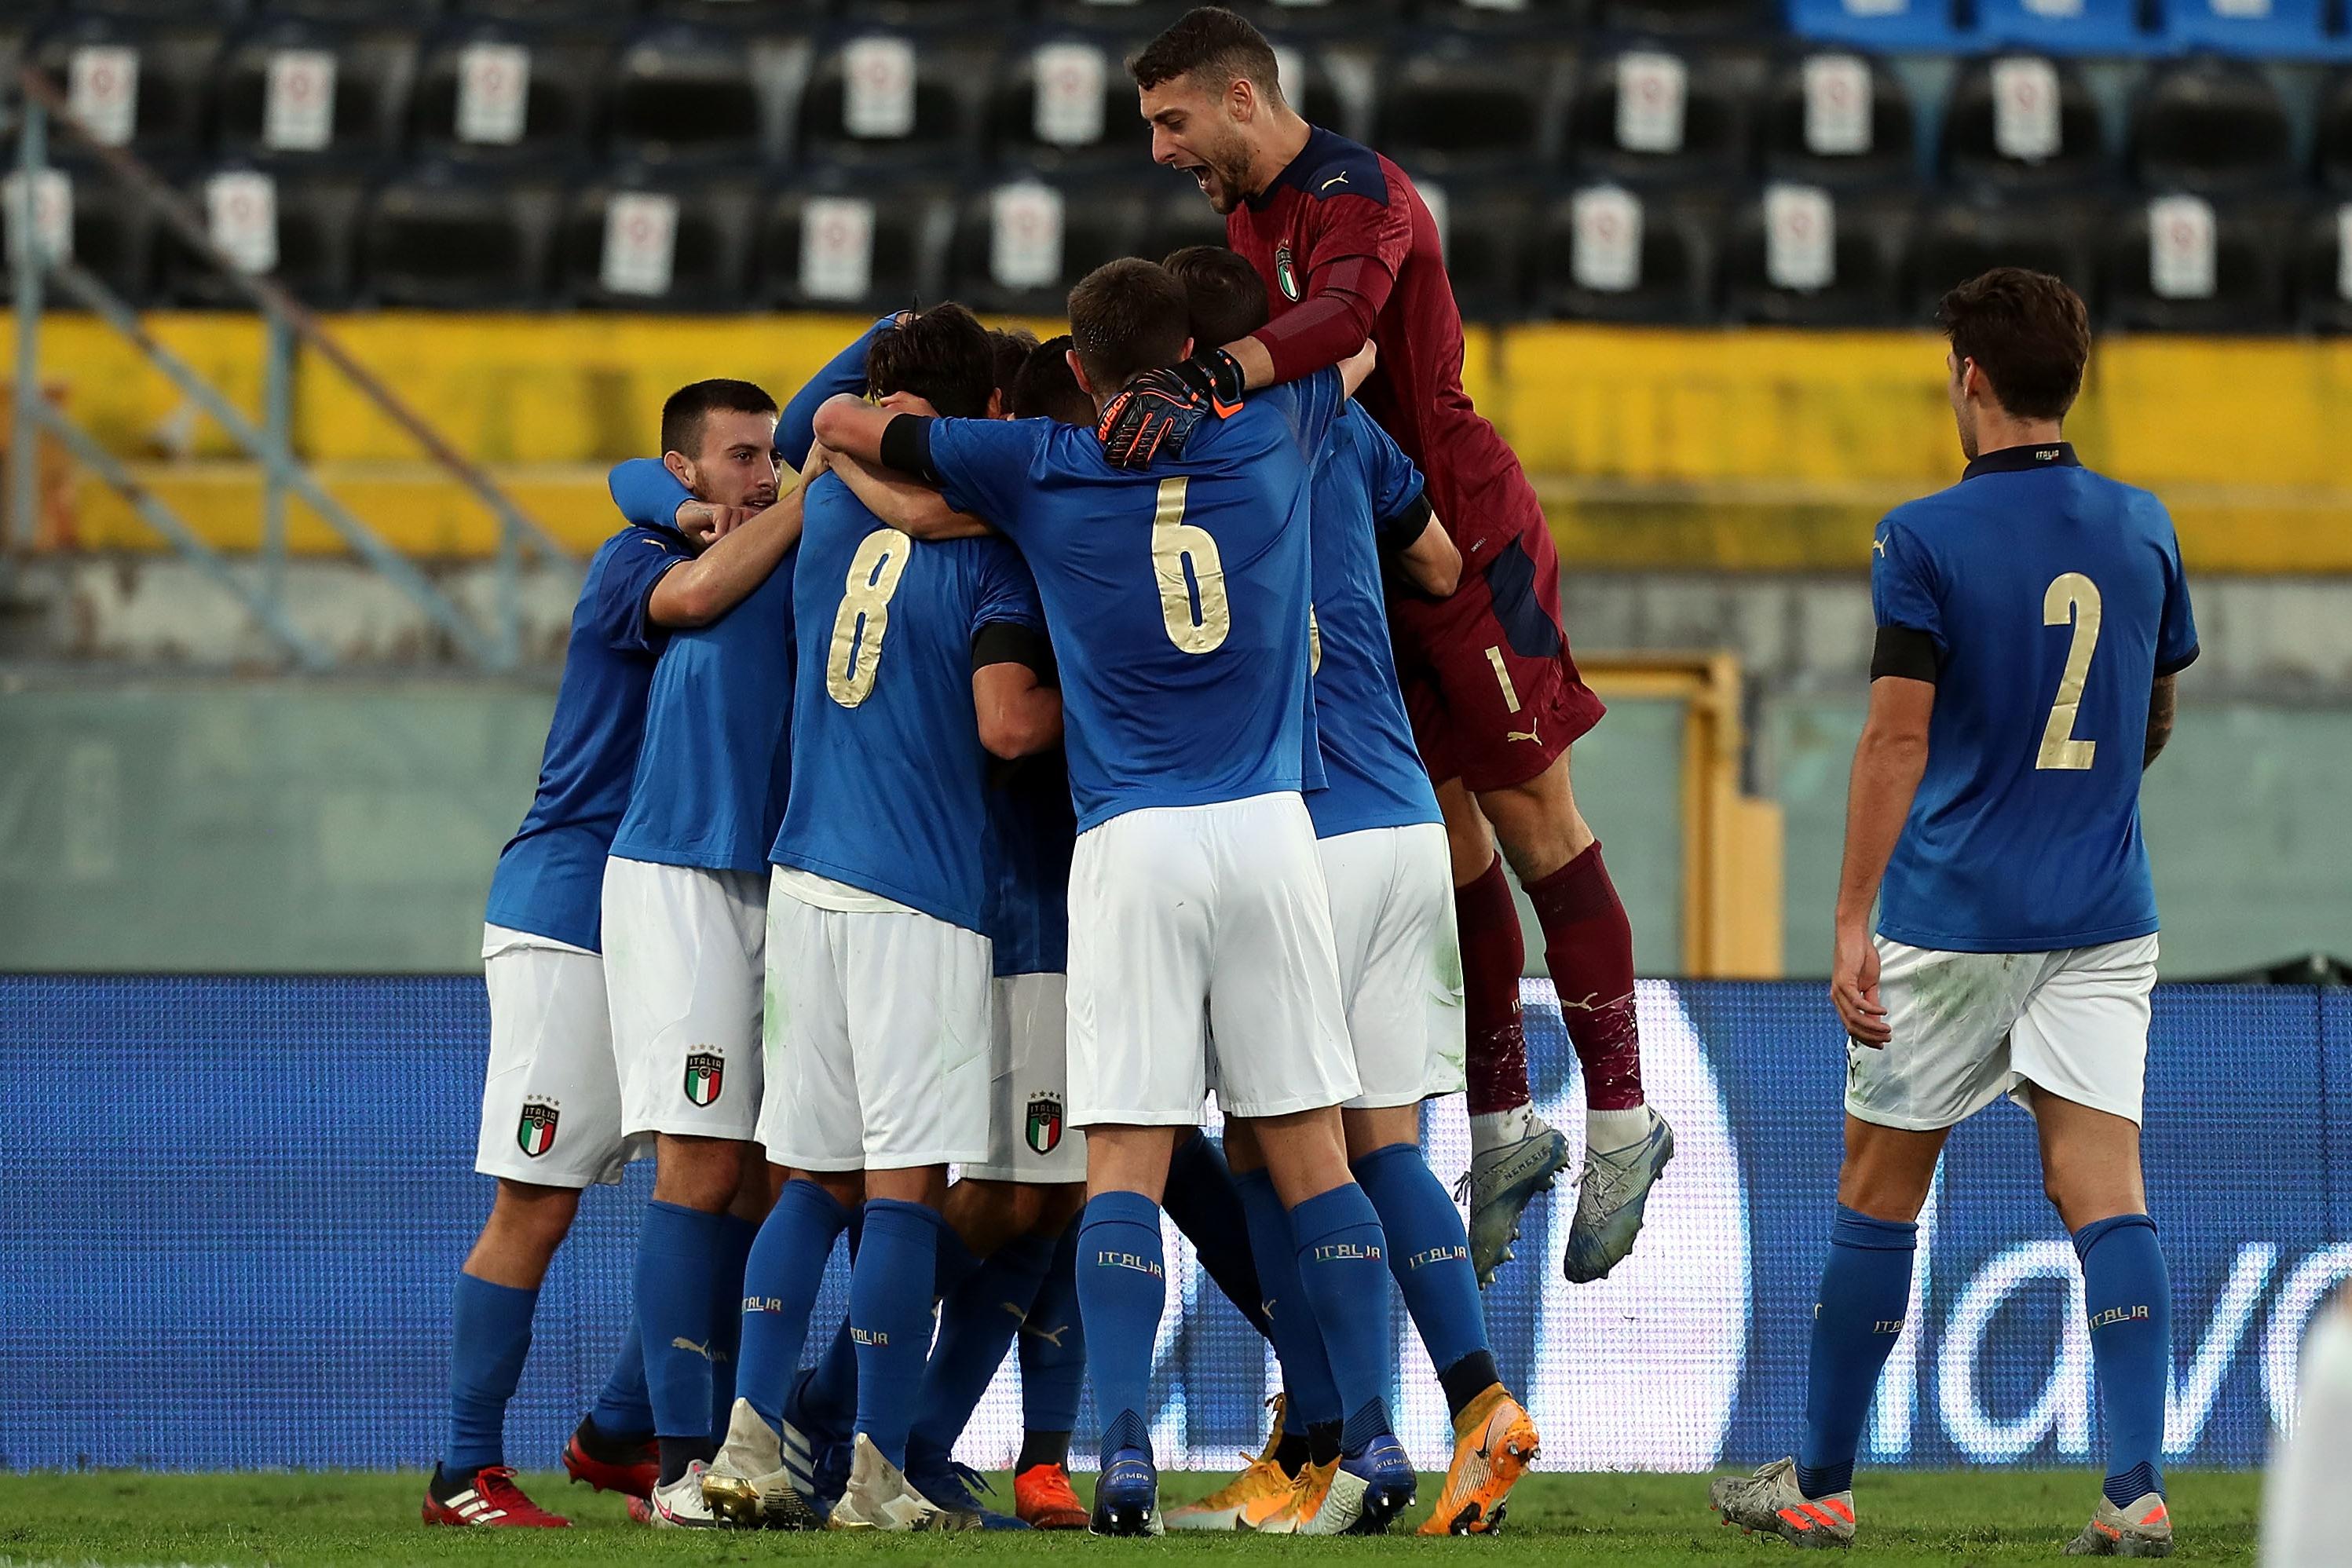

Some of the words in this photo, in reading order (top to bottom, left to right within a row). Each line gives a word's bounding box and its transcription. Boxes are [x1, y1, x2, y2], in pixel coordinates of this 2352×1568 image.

[2036, 449, 2060, 459] ITALIA
[1152, 477, 1231, 655] 6
[826, 528, 911, 709] 8
[1484, 645, 1522, 714] 1
[2035, 572, 2101, 771] 2
[690, 1058, 722, 1068] ITALIA
[525, 1107, 557, 1120] ITALIA
[1030, 1104, 1060, 1114] ITALIA
[1315, 1244, 1381, 1259] ITALIA
[1409, 1245, 1467, 1269] ITALIA
[1098, 1251, 1162, 1278] ITALIA
[2089, 1305, 2149, 1329] ITALIA
